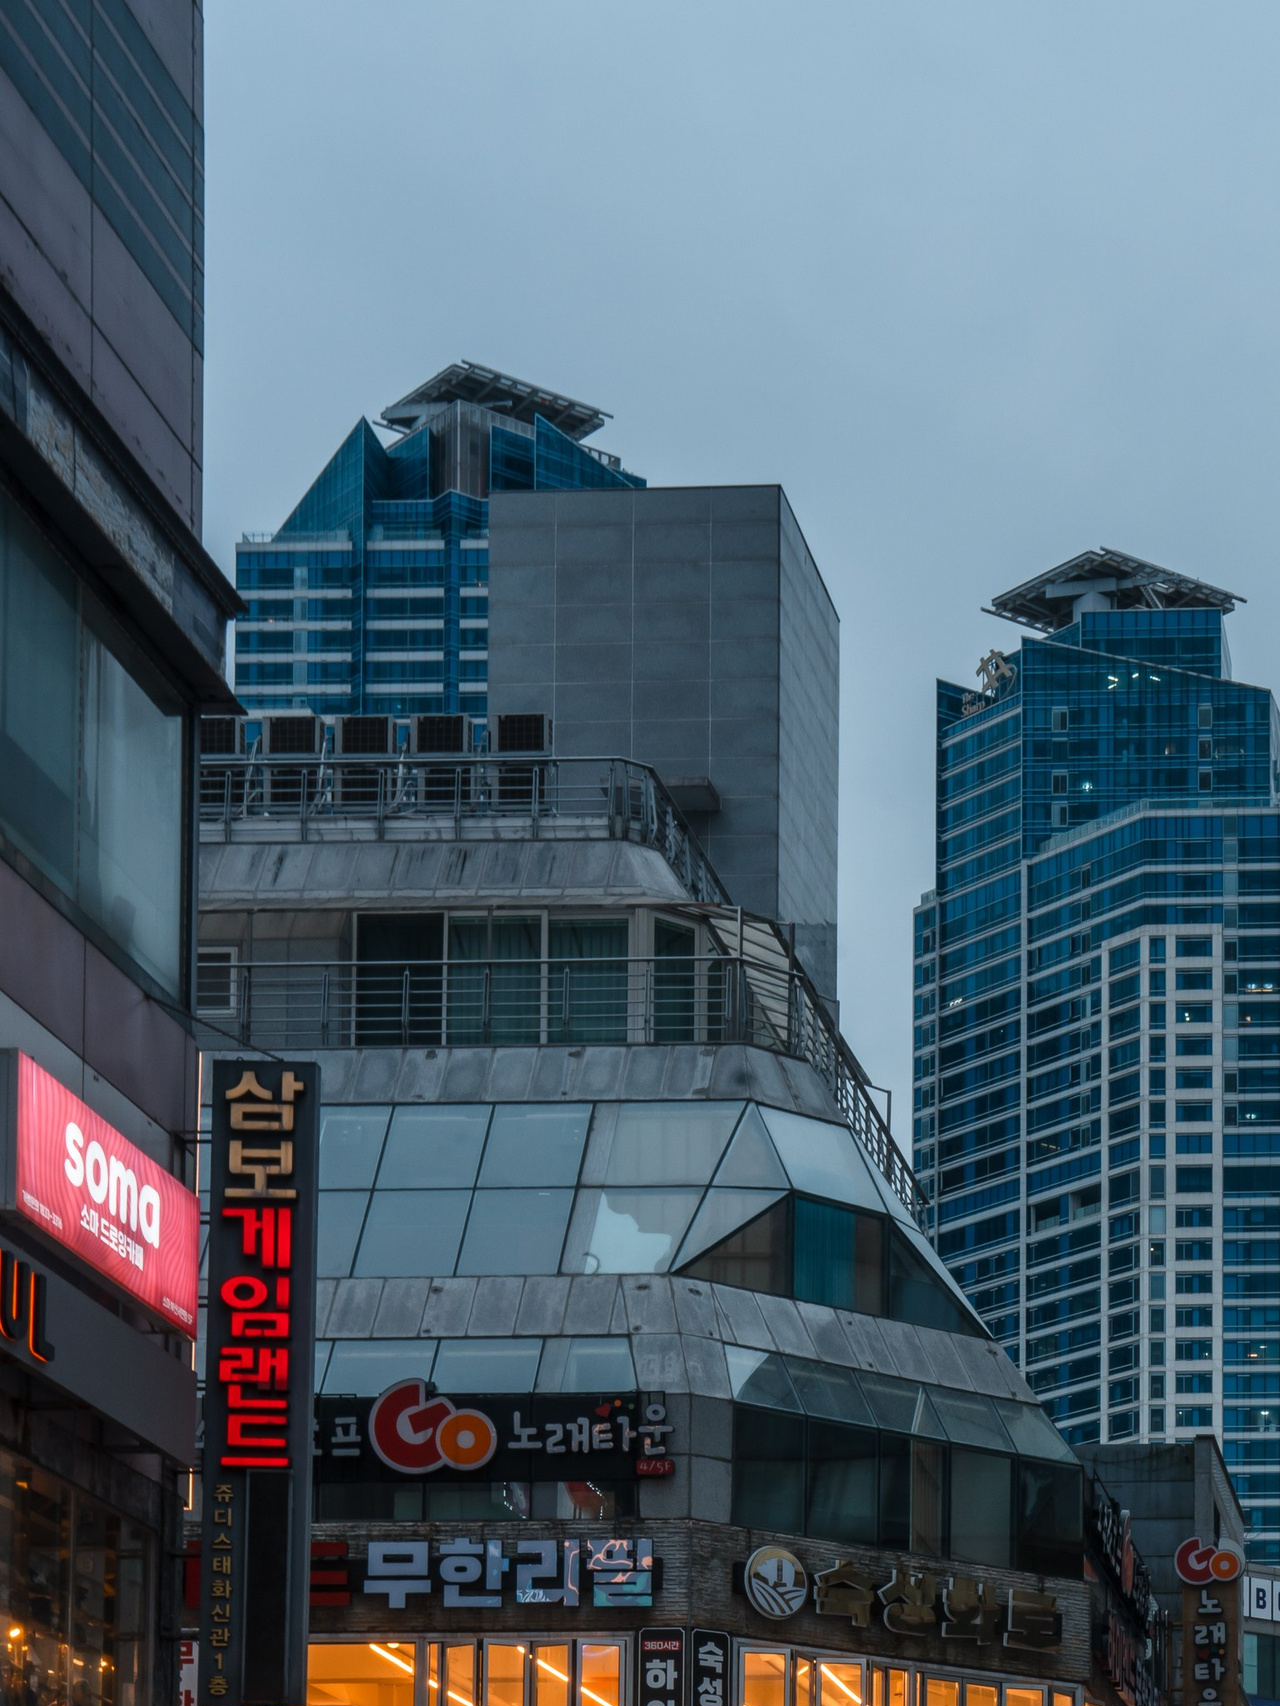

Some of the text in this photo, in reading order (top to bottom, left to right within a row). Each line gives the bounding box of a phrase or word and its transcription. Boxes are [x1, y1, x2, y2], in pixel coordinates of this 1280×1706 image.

[224, 1069, 304, 1199] 삼보
[64, 1121, 161, 1249] soma
[80, 1203, 144, 1271] 소마 드로잉카페
[218, 1206, 292, 1468] 게임랜드
[507, 1402, 675, 1456] 노래타운
[363, 1537, 654, 1609] 무한리필
[644, 1641, 680, 1651] 360시간
